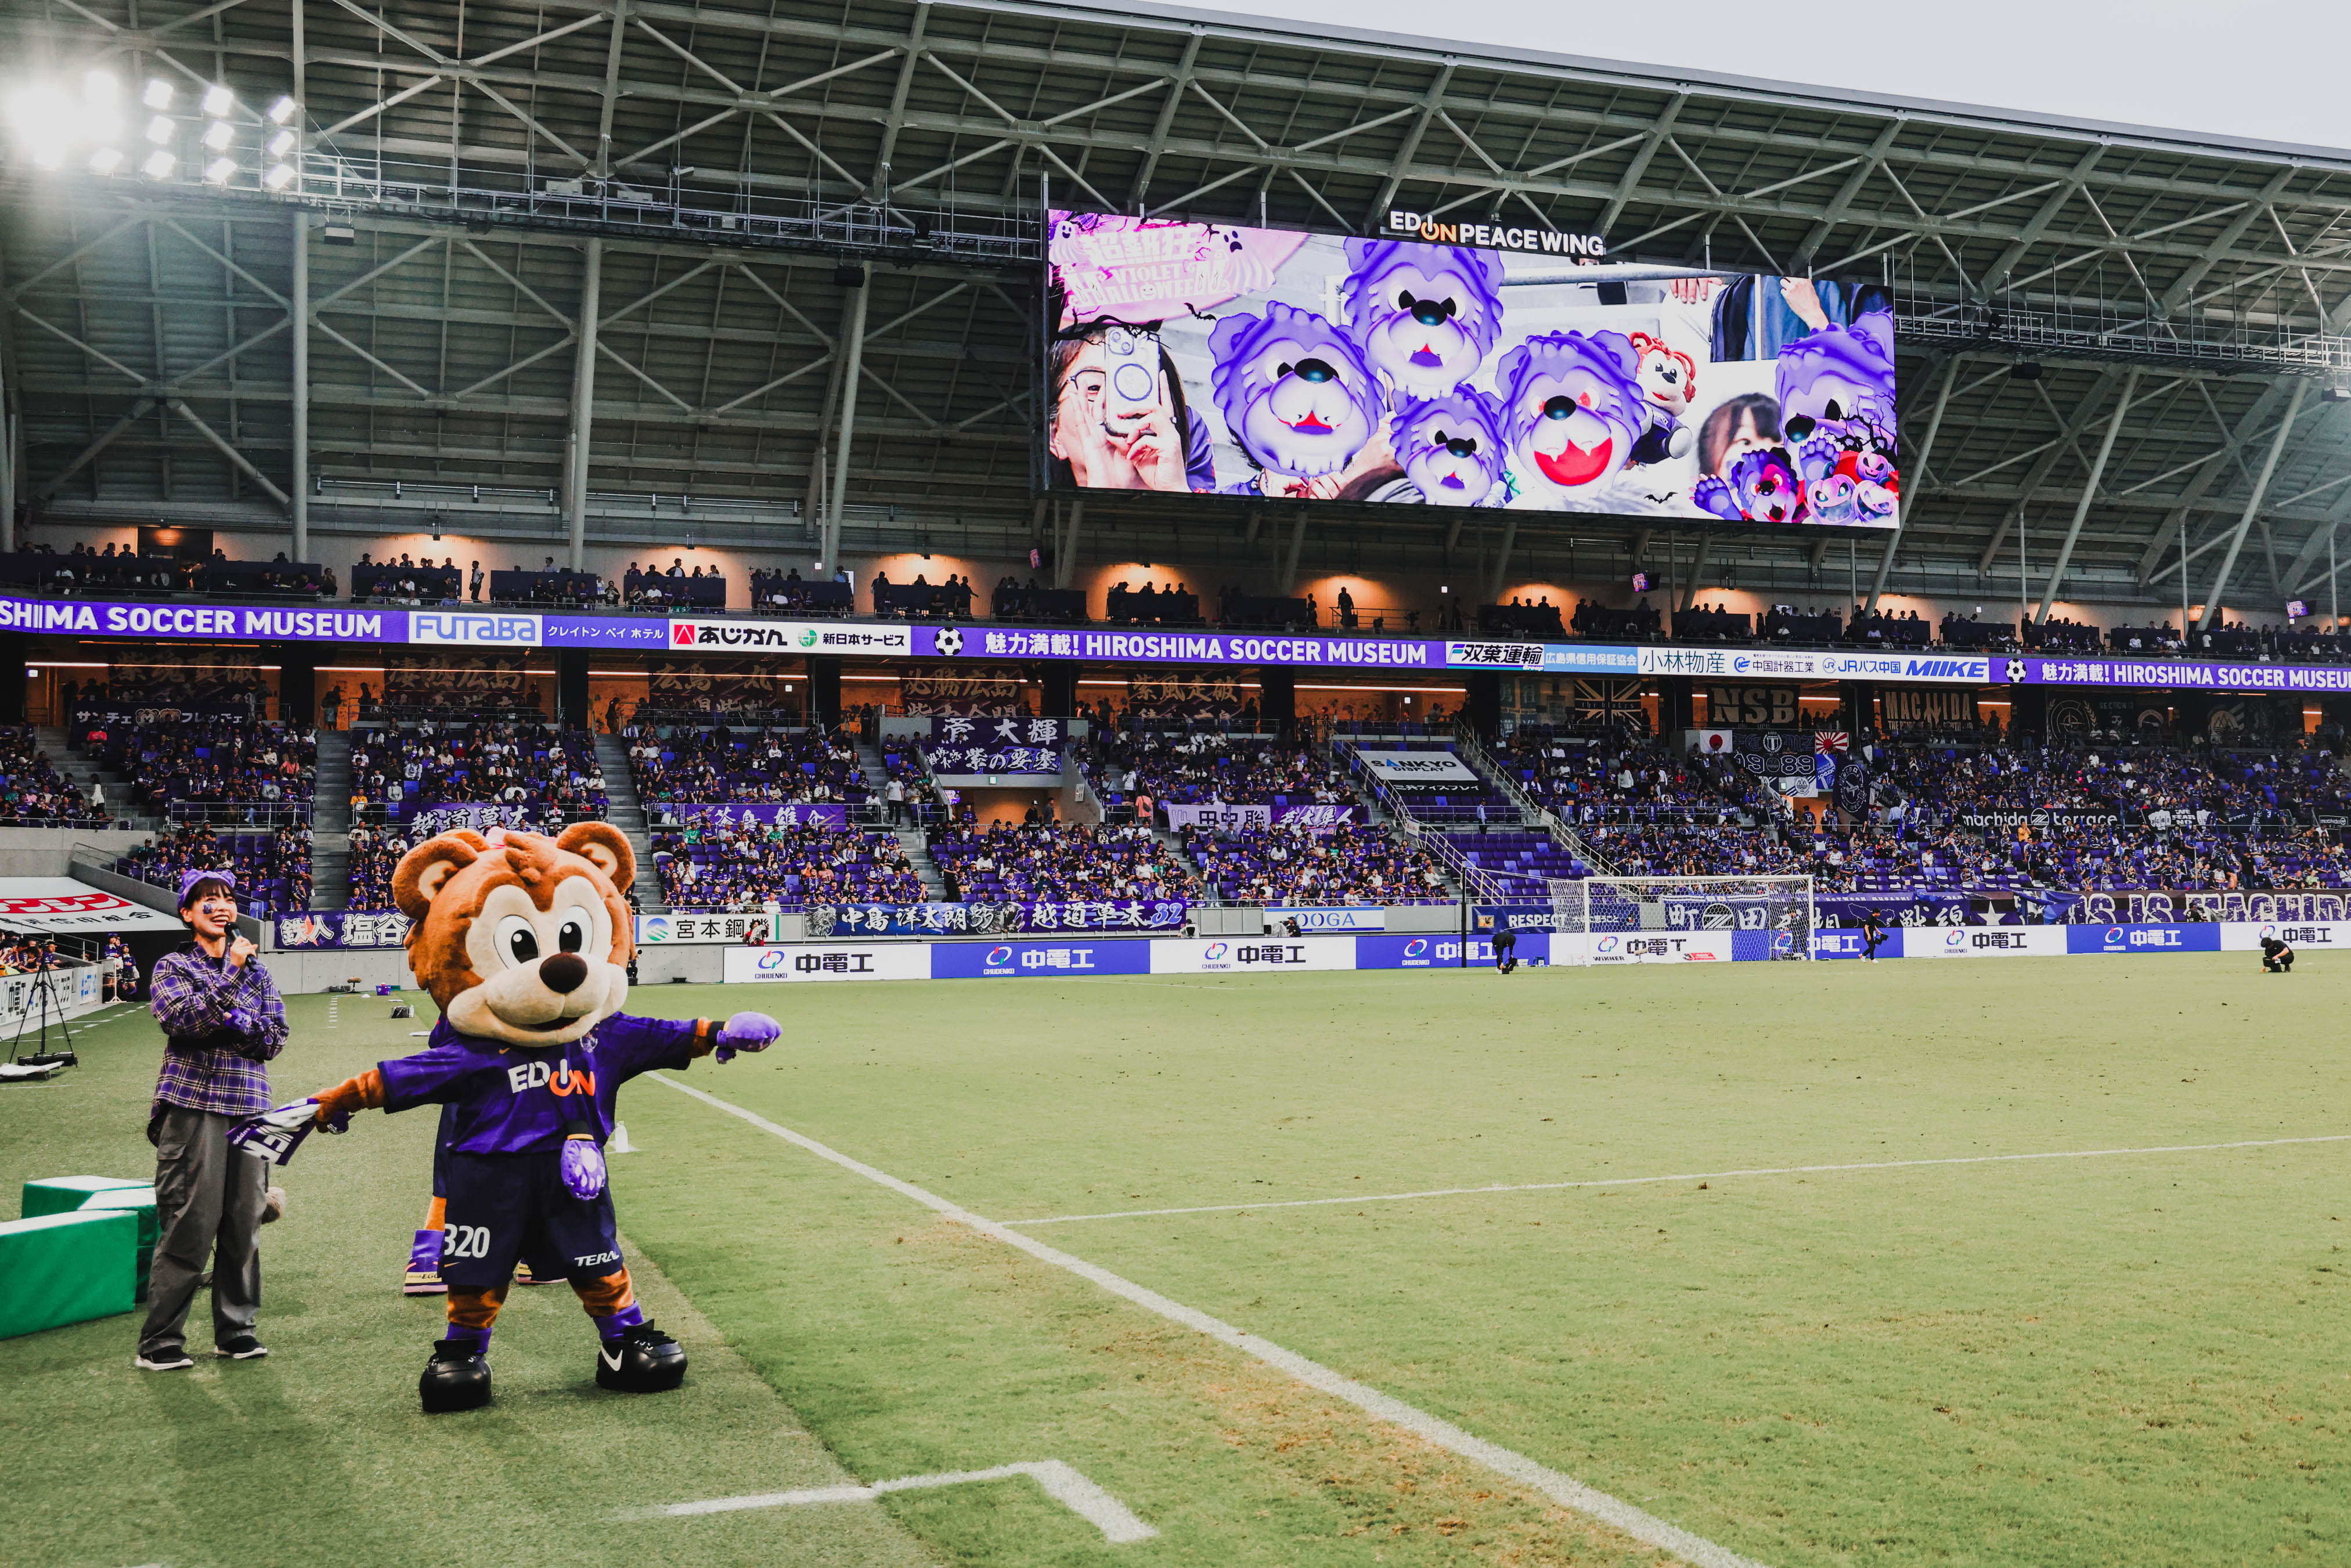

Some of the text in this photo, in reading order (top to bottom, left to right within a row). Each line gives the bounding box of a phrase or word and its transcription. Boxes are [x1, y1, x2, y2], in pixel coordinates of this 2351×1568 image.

[1390, 211, 1604, 256] EDION PEACE WING
[1112, 264, 1182, 284] VIOLET
[107, 607, 236, 634] SOCCER
[245, 611, 381, 638] MUSEUM
[547, 625, 664, 640] クレイトン ベイ ホテル
[698, 626, 788, 647] あじかん
[822, 633, 905, 647] 新日本サービス
[985, 631, 1426, 665] 魅力満載! HIROSHIMA SOCCER MUSEUM
[1463, 644, 1544, 665] 双葉運輸
[1545, 651, 1637, 666] 広島県信用保証協会
[1642, 649, 1726, 674] 小林物産
[1752, 659, 1815, 674] 中国計器工業
[1838, 660, 1901, 674] JRバス中国
[1905, 660, 1988, 677] MIIKE
[2042, 662, 2351, 689] 魅力満載! HIROSHIMA SOCCER MUSEU
[1711, 687, 1795, 724] NSB
[964, 747, 1059, 772] 紫の要塞
[1371, 759, 1457, 767] SANKYO
[841, 906, 967, 932] 中島洋太朗
[1151, 902, 1184, 925] 32
[280, 913, 409, 946] 鉄人 塩谷
[2129, 929, 2183, 947] 中電工
[2282, 927, 2332, 944] 中電工
[1972, 932, 2028, 949] 中電工
[795, 953, 875, 974] 中電工
[1021, 949, 1095, 969] 中電工
[1237, 945, 1307, 964] 中電工
[507, 1058, 596, 1097] EDION
